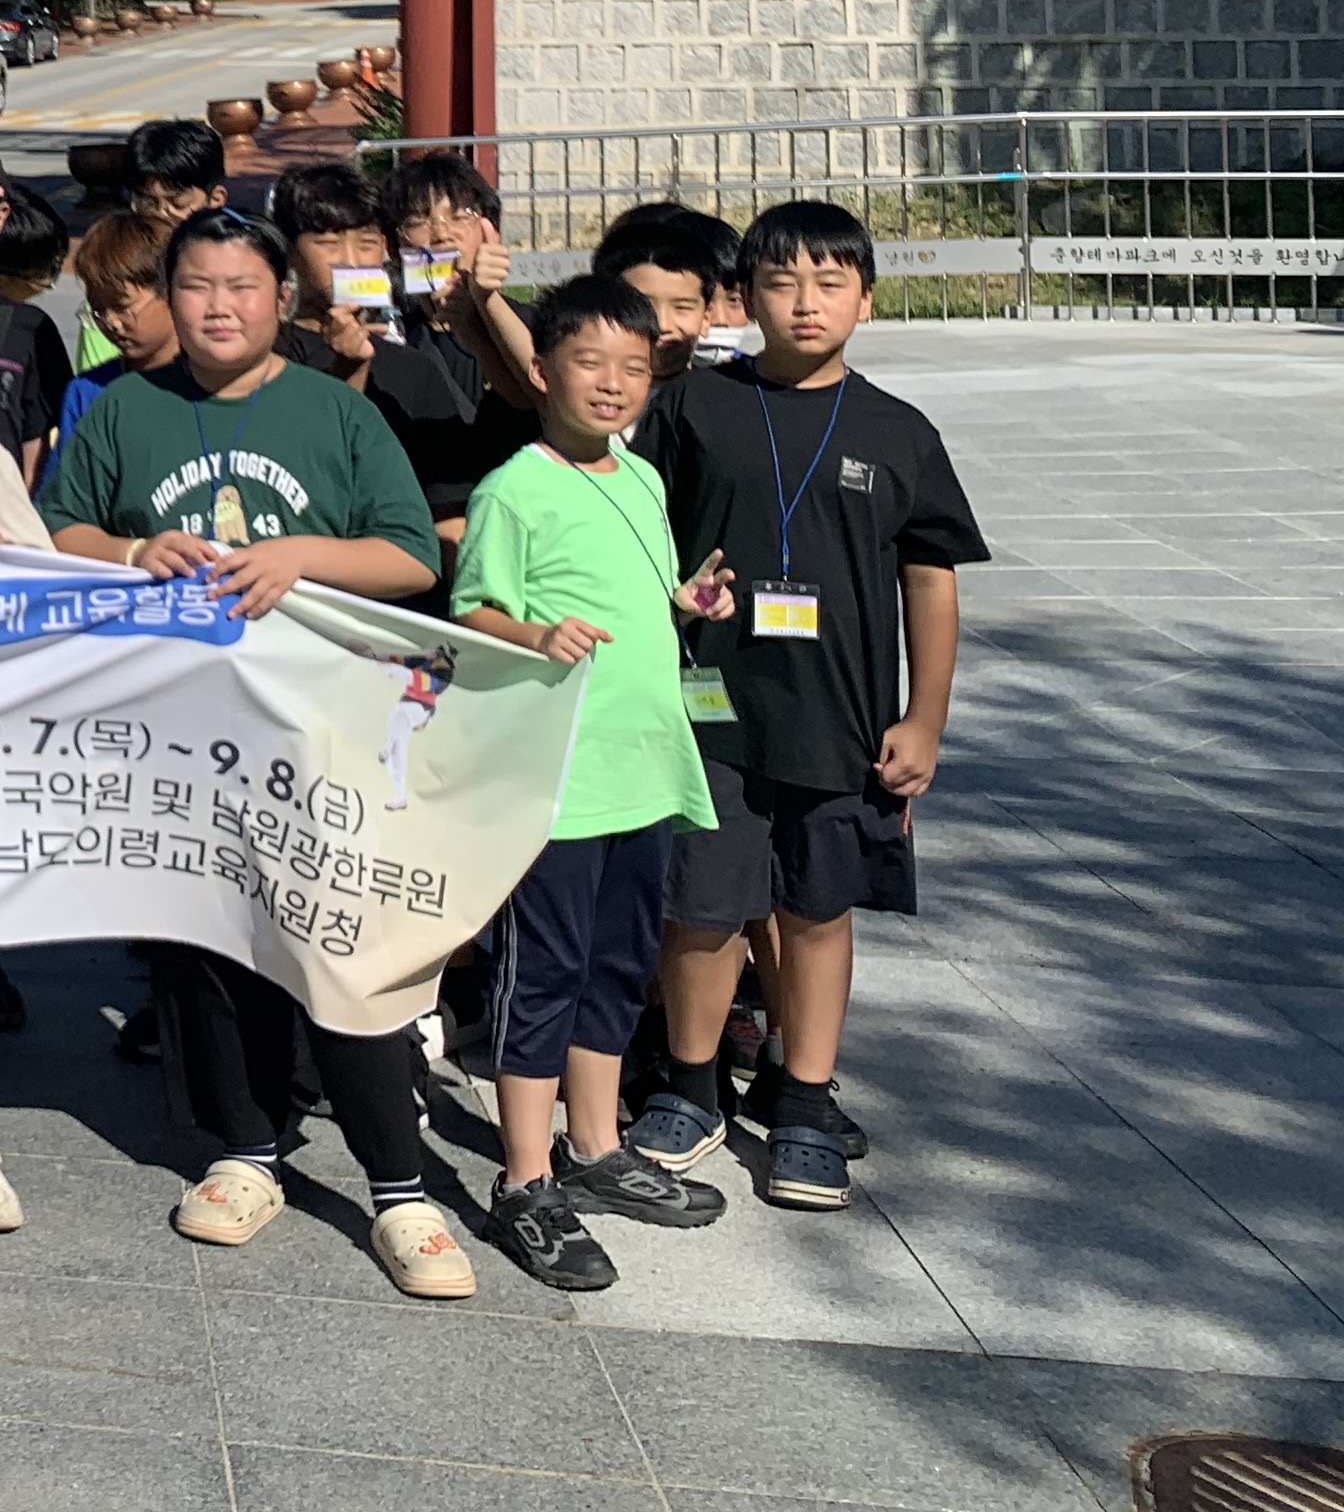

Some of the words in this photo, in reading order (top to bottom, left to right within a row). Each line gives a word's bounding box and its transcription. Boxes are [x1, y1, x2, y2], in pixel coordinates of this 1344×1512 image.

[1050, 246, 1177, 265] 춘향테마파크에
[1190, 247, 1264, 266] 오신것을
[150, 451, 222, 517] HOLIDAY
[228, 448, 310, 517] TOGETHER
[180, 513, 204, 535] 18
[252, 513, 281, 537] 43
[41, 582, 221, 632] 교육활동
[151, 776, 193, 821] 및
[211, 788, 448, 919] 남원광한루원
